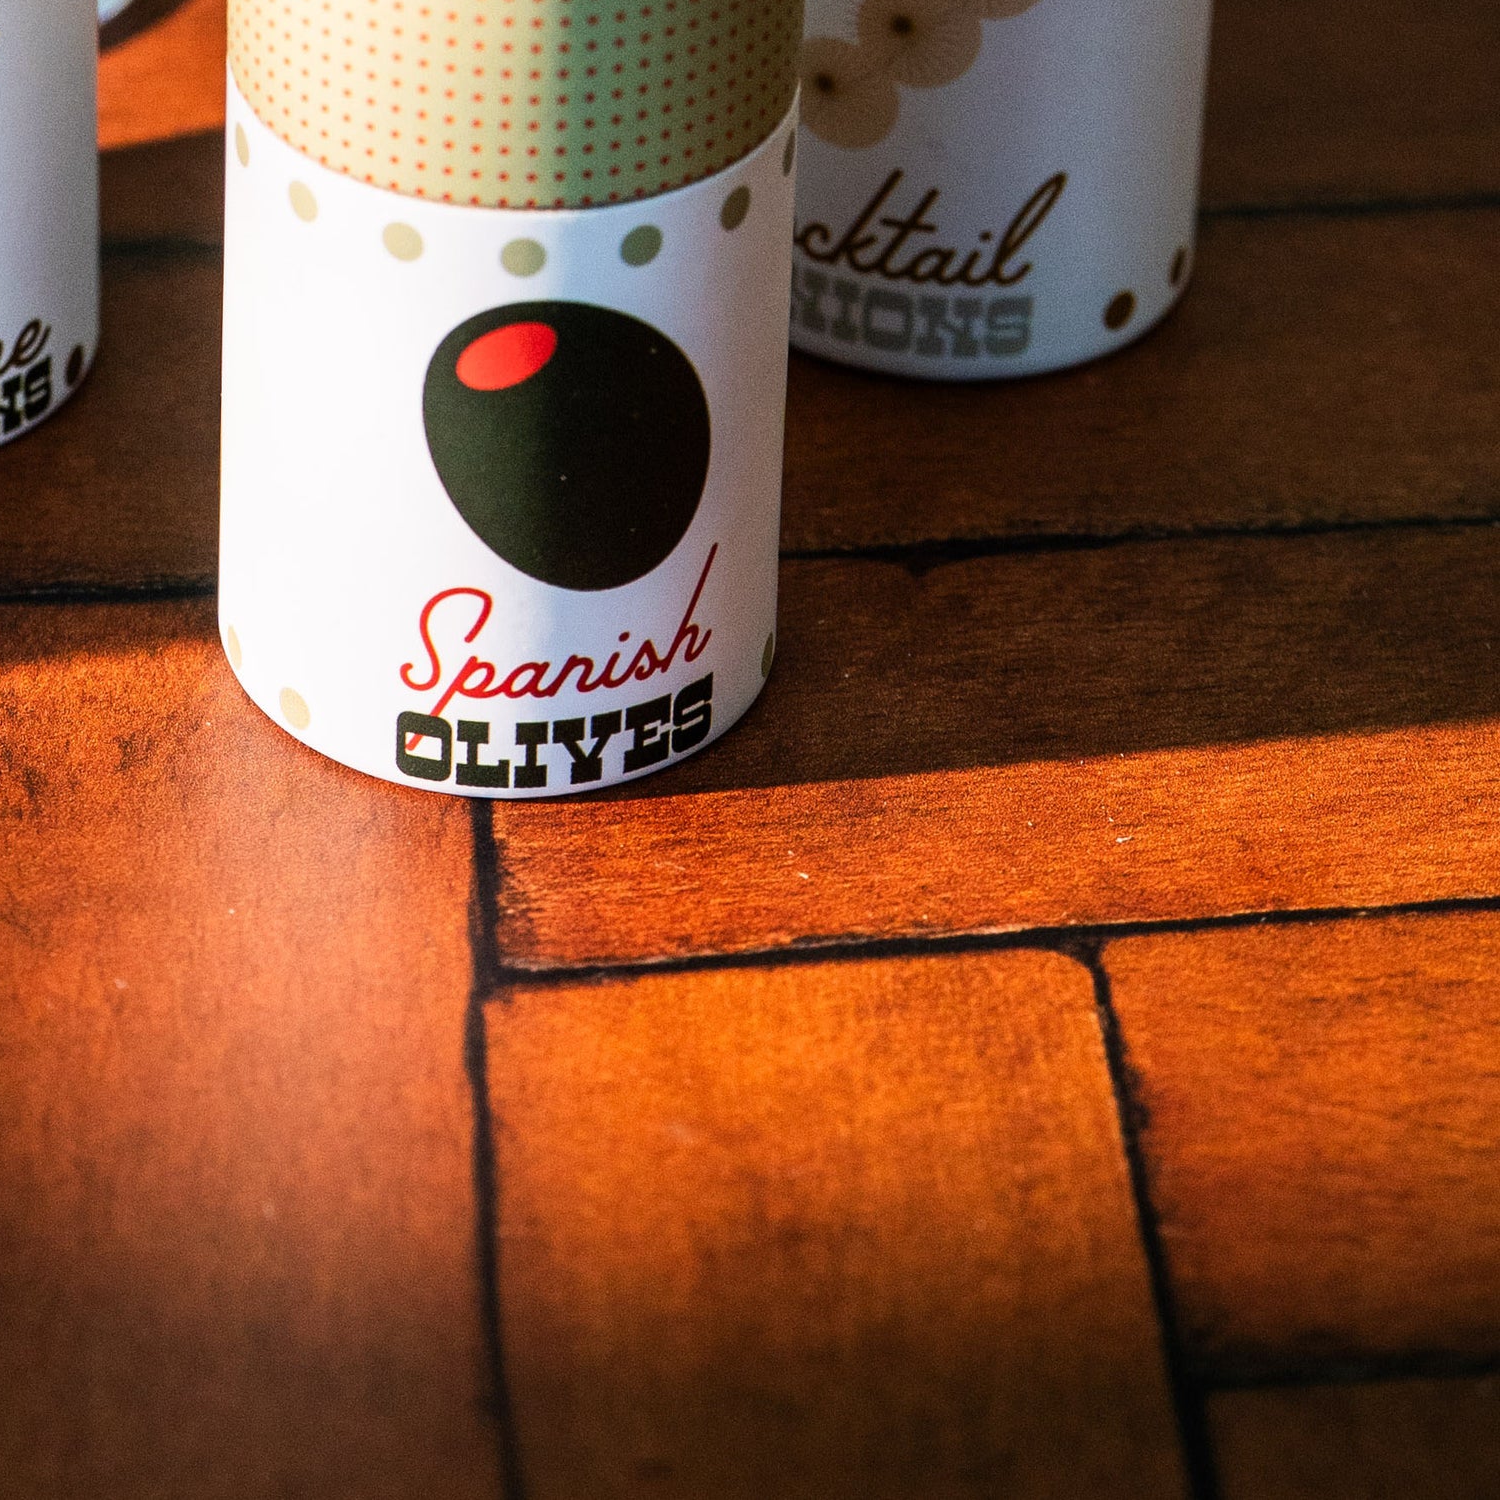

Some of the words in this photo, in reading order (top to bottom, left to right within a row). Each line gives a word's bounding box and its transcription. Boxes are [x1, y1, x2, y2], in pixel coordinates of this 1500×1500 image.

[793, 167, 1068, 287] cktail
[399, 541, 719, 752] Spanish
[396, 671, 714, 789] OLIVES
